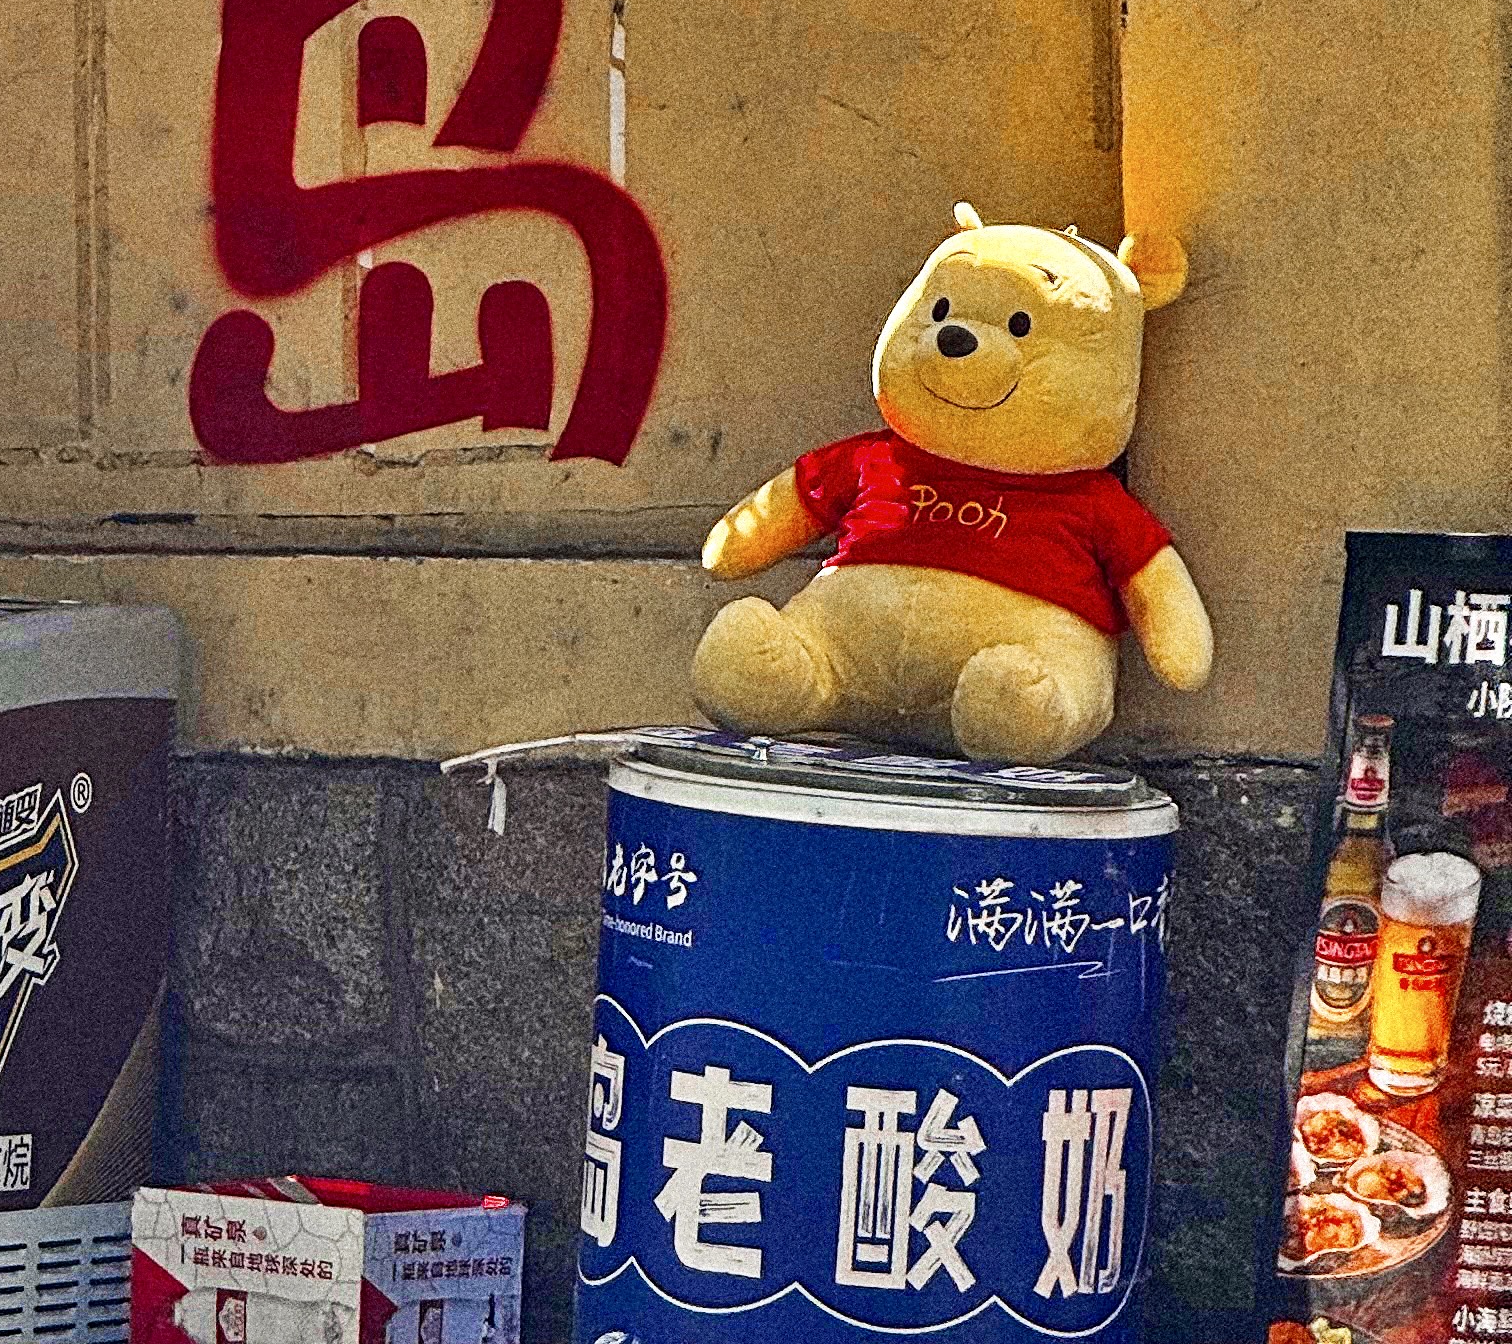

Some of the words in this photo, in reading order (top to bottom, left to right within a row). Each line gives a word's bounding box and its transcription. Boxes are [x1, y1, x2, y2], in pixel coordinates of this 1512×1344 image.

[909, 484, 1008, 539] Pooh
[1381, 587, 1512, 667] 山栖
[602, 840, 698, 911] 老字号
[654, 923, 694, 948] Brand
[1464, 1185, 1512, 1215] 主食
[180, 1213, 247, 1243] 真矿泉
[181, 1243, 334, 1280] 一瓶来自地球深处的
